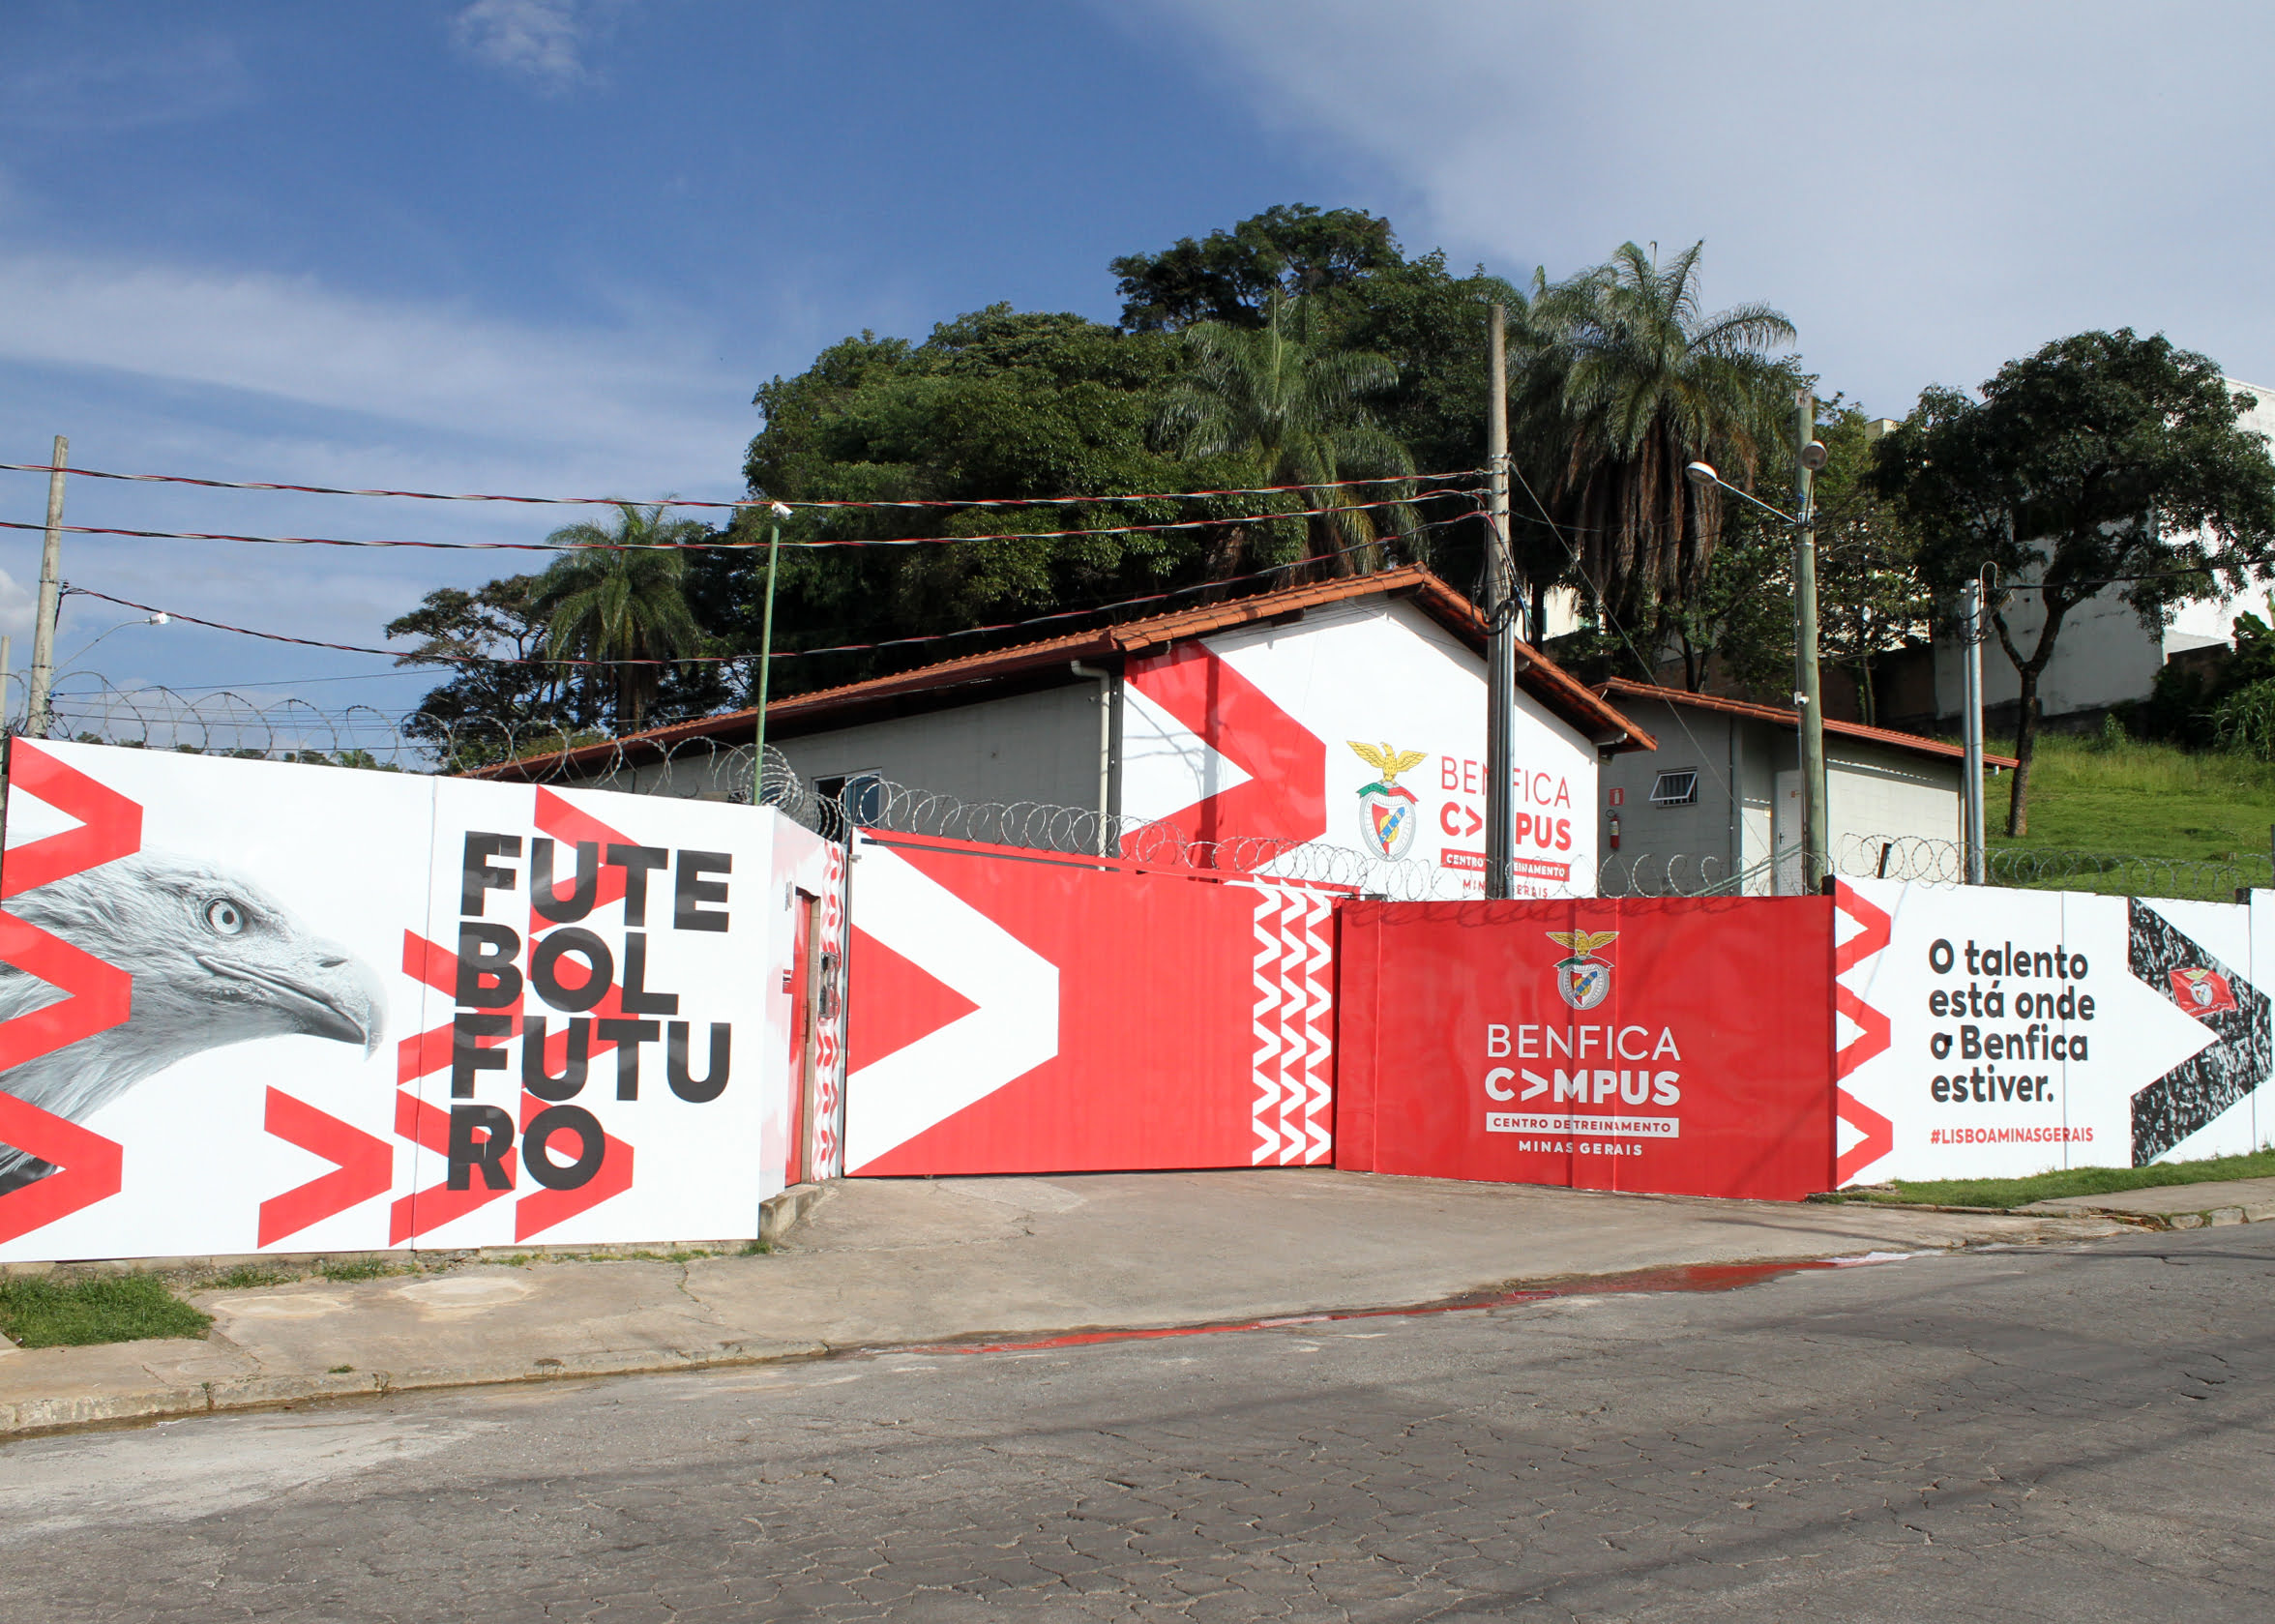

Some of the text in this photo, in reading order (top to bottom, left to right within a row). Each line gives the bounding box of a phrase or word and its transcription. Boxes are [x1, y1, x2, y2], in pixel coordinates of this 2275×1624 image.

[1441, 755, 1571, 810] BEICA
[460, 831, 732, 932] FUTE
[1446, 854, 1565, 877] CENTRO EINAMENTO
[1513, 884, 1548, 898] ERAIS
[456, 921, 679, 1015] BOL
[1929, 938, 2088, 980] O talento
[1929, 980, 2095, 1020] está onde
[451, 1013, 731, 1104] FUTU
[1487, 1023, 1681, 1061] BENFICA
[1961, 1023, 2088, 1062] Benfica
[1931, 1064, 2054, 1103] estiver.
[1493, 1117, 1671, 1133] CENTRO DE TREINAMENTO
[1931, 1127, 2094, 1144] #LISBOAMINASGERAIS
[446, 1105, 606, 1191] RO
[1519, 1140, 1642, 1156] MINAS GERAIS
